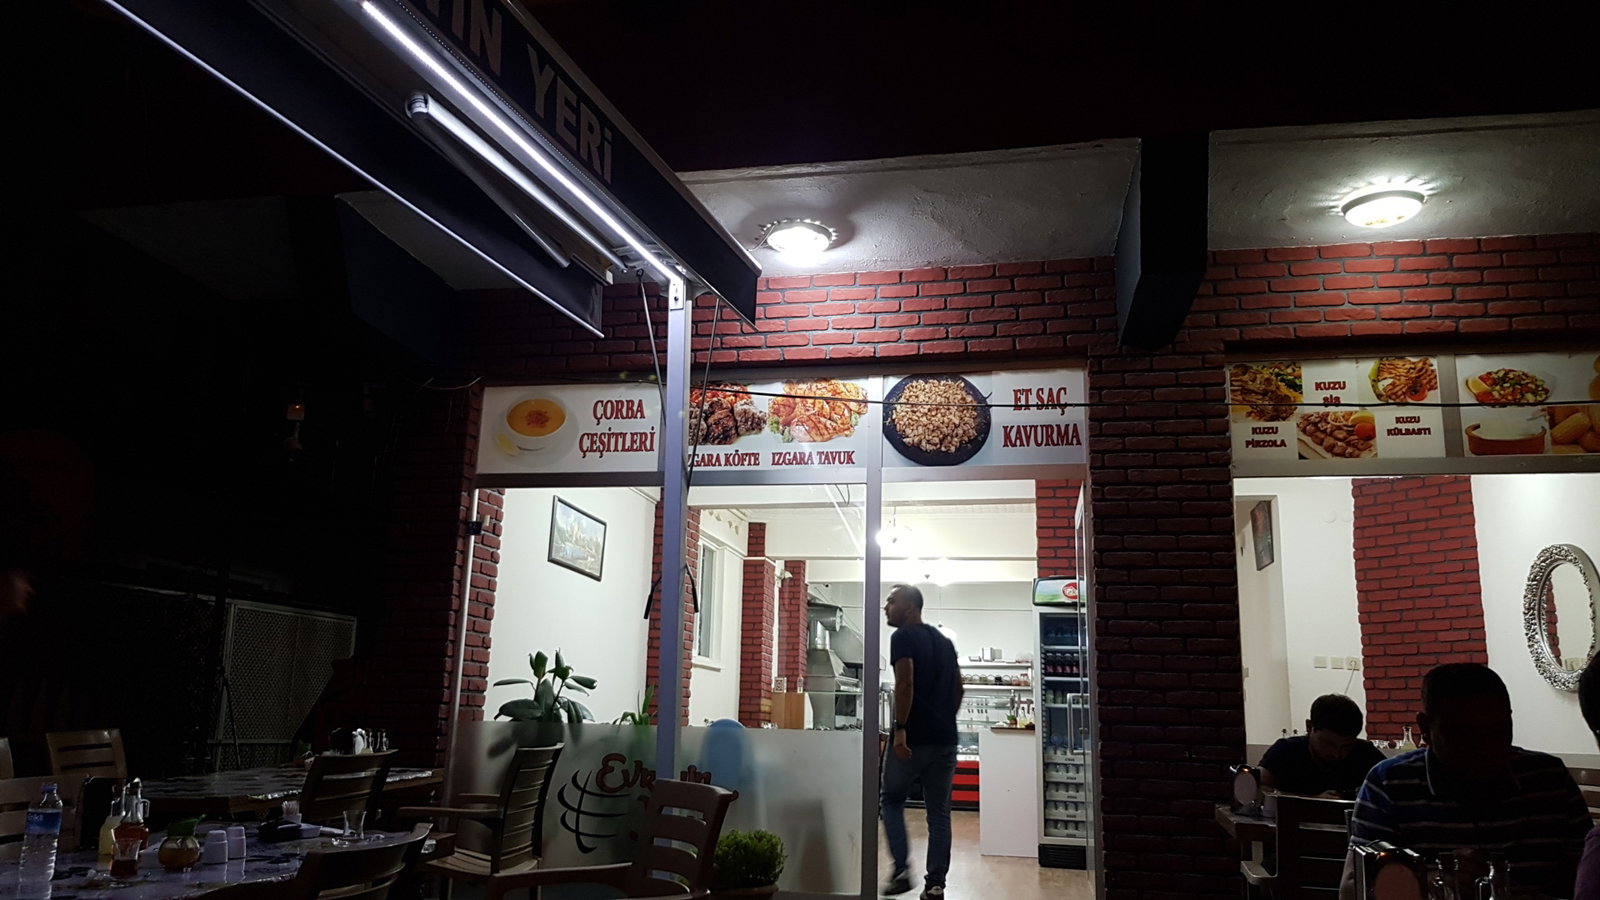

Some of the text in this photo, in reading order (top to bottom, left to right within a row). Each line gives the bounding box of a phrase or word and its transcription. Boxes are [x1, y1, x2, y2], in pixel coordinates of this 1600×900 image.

[1315, 381, 1346, 391] KUZU
[1012, 387, 1068, 416] ET SAÇ
[592, 399, 646, 426] ÇORBA
[1395, 415, 1421, 424] KUZU
[1002, 423, 1082, 448] KAVURMA
[1251, 426, 1278, 435] KUZU
[578, 426, 657, 459] ÇEŞİTLERİ
[1245, 438, 1287, 448] PİRZOLA
[724, 449, 760, 467] KÖFTE
[771, 450, 855, 466] IZGARA TAVUK
